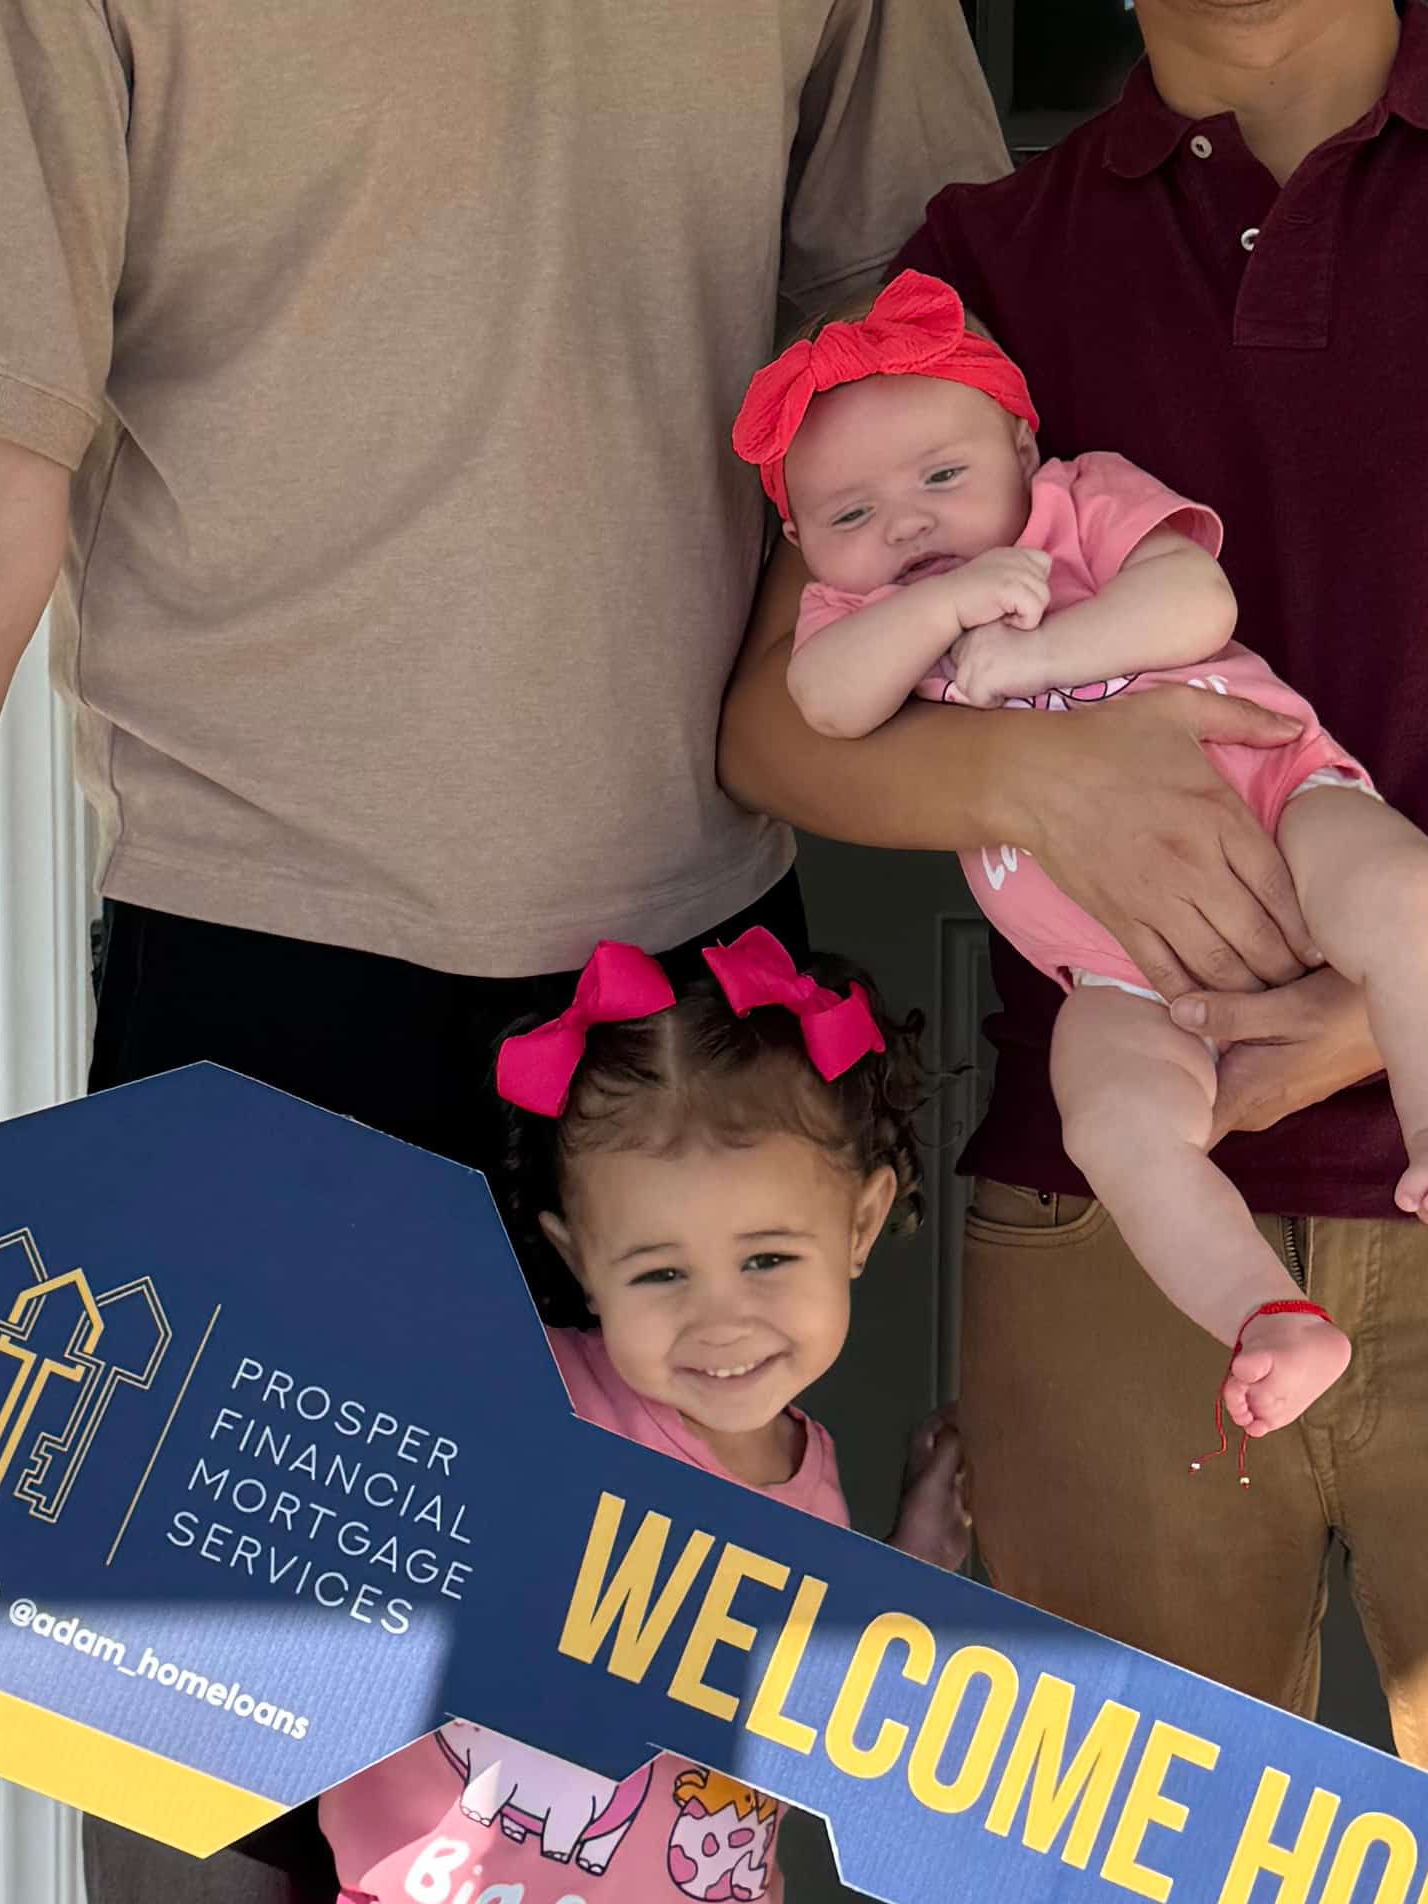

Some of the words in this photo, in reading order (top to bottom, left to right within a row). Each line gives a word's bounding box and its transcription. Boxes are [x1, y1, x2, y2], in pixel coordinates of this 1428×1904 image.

[210, 1408, 474, 1545] FINANCIAL
[231, 1356, 459, 1477] PROSPER
[166, 1510, 413, 1636] SERVICES
[187, 1458, 475, 1602] MORTGAGE
[8, 1599, 310, 1741] @adam_homeloans
[557, 1491, 1222, 1904] WELCOME
